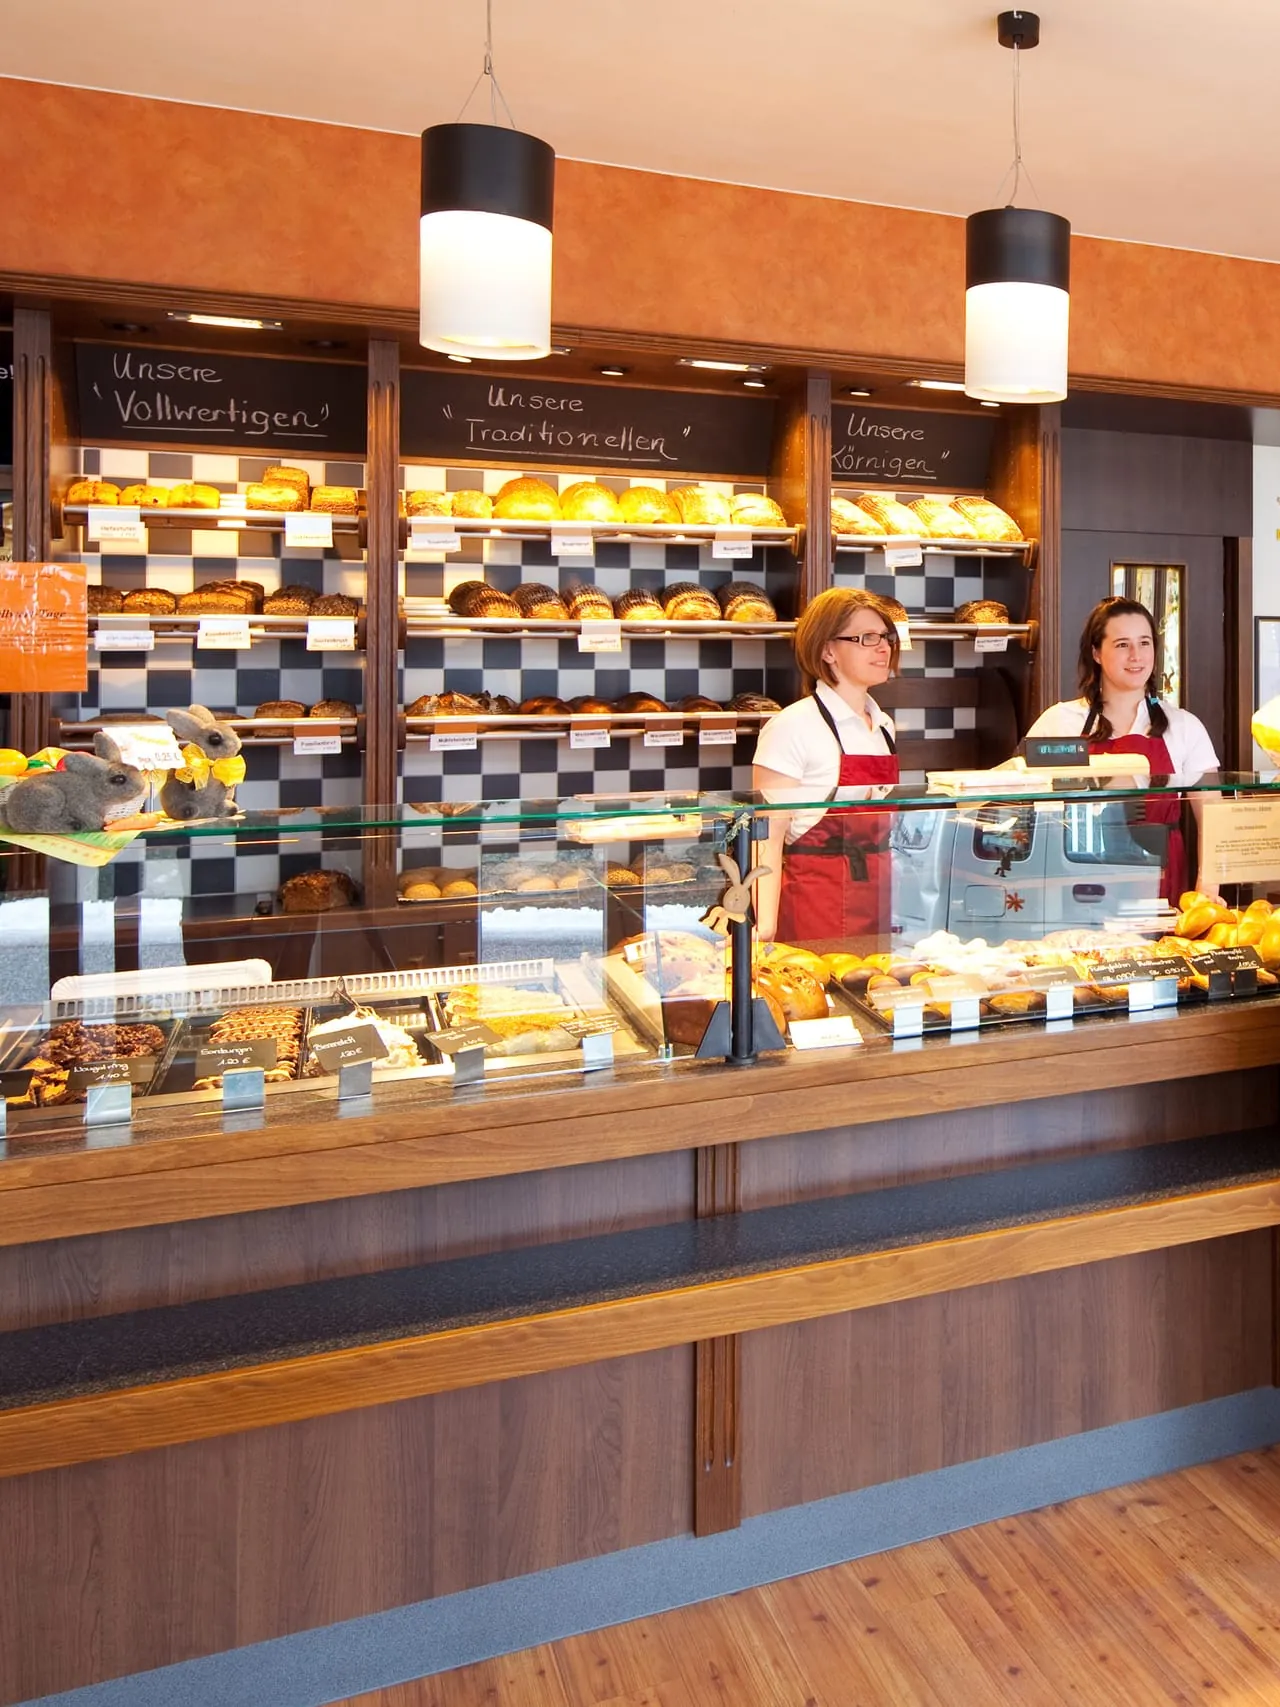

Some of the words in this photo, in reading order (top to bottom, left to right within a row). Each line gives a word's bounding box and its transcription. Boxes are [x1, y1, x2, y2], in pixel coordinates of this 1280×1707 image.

[113, 353, 223, 383] Unsere
[487, 385, 584, 412] Unsere
[847, 413, 925, 440] Unsere
